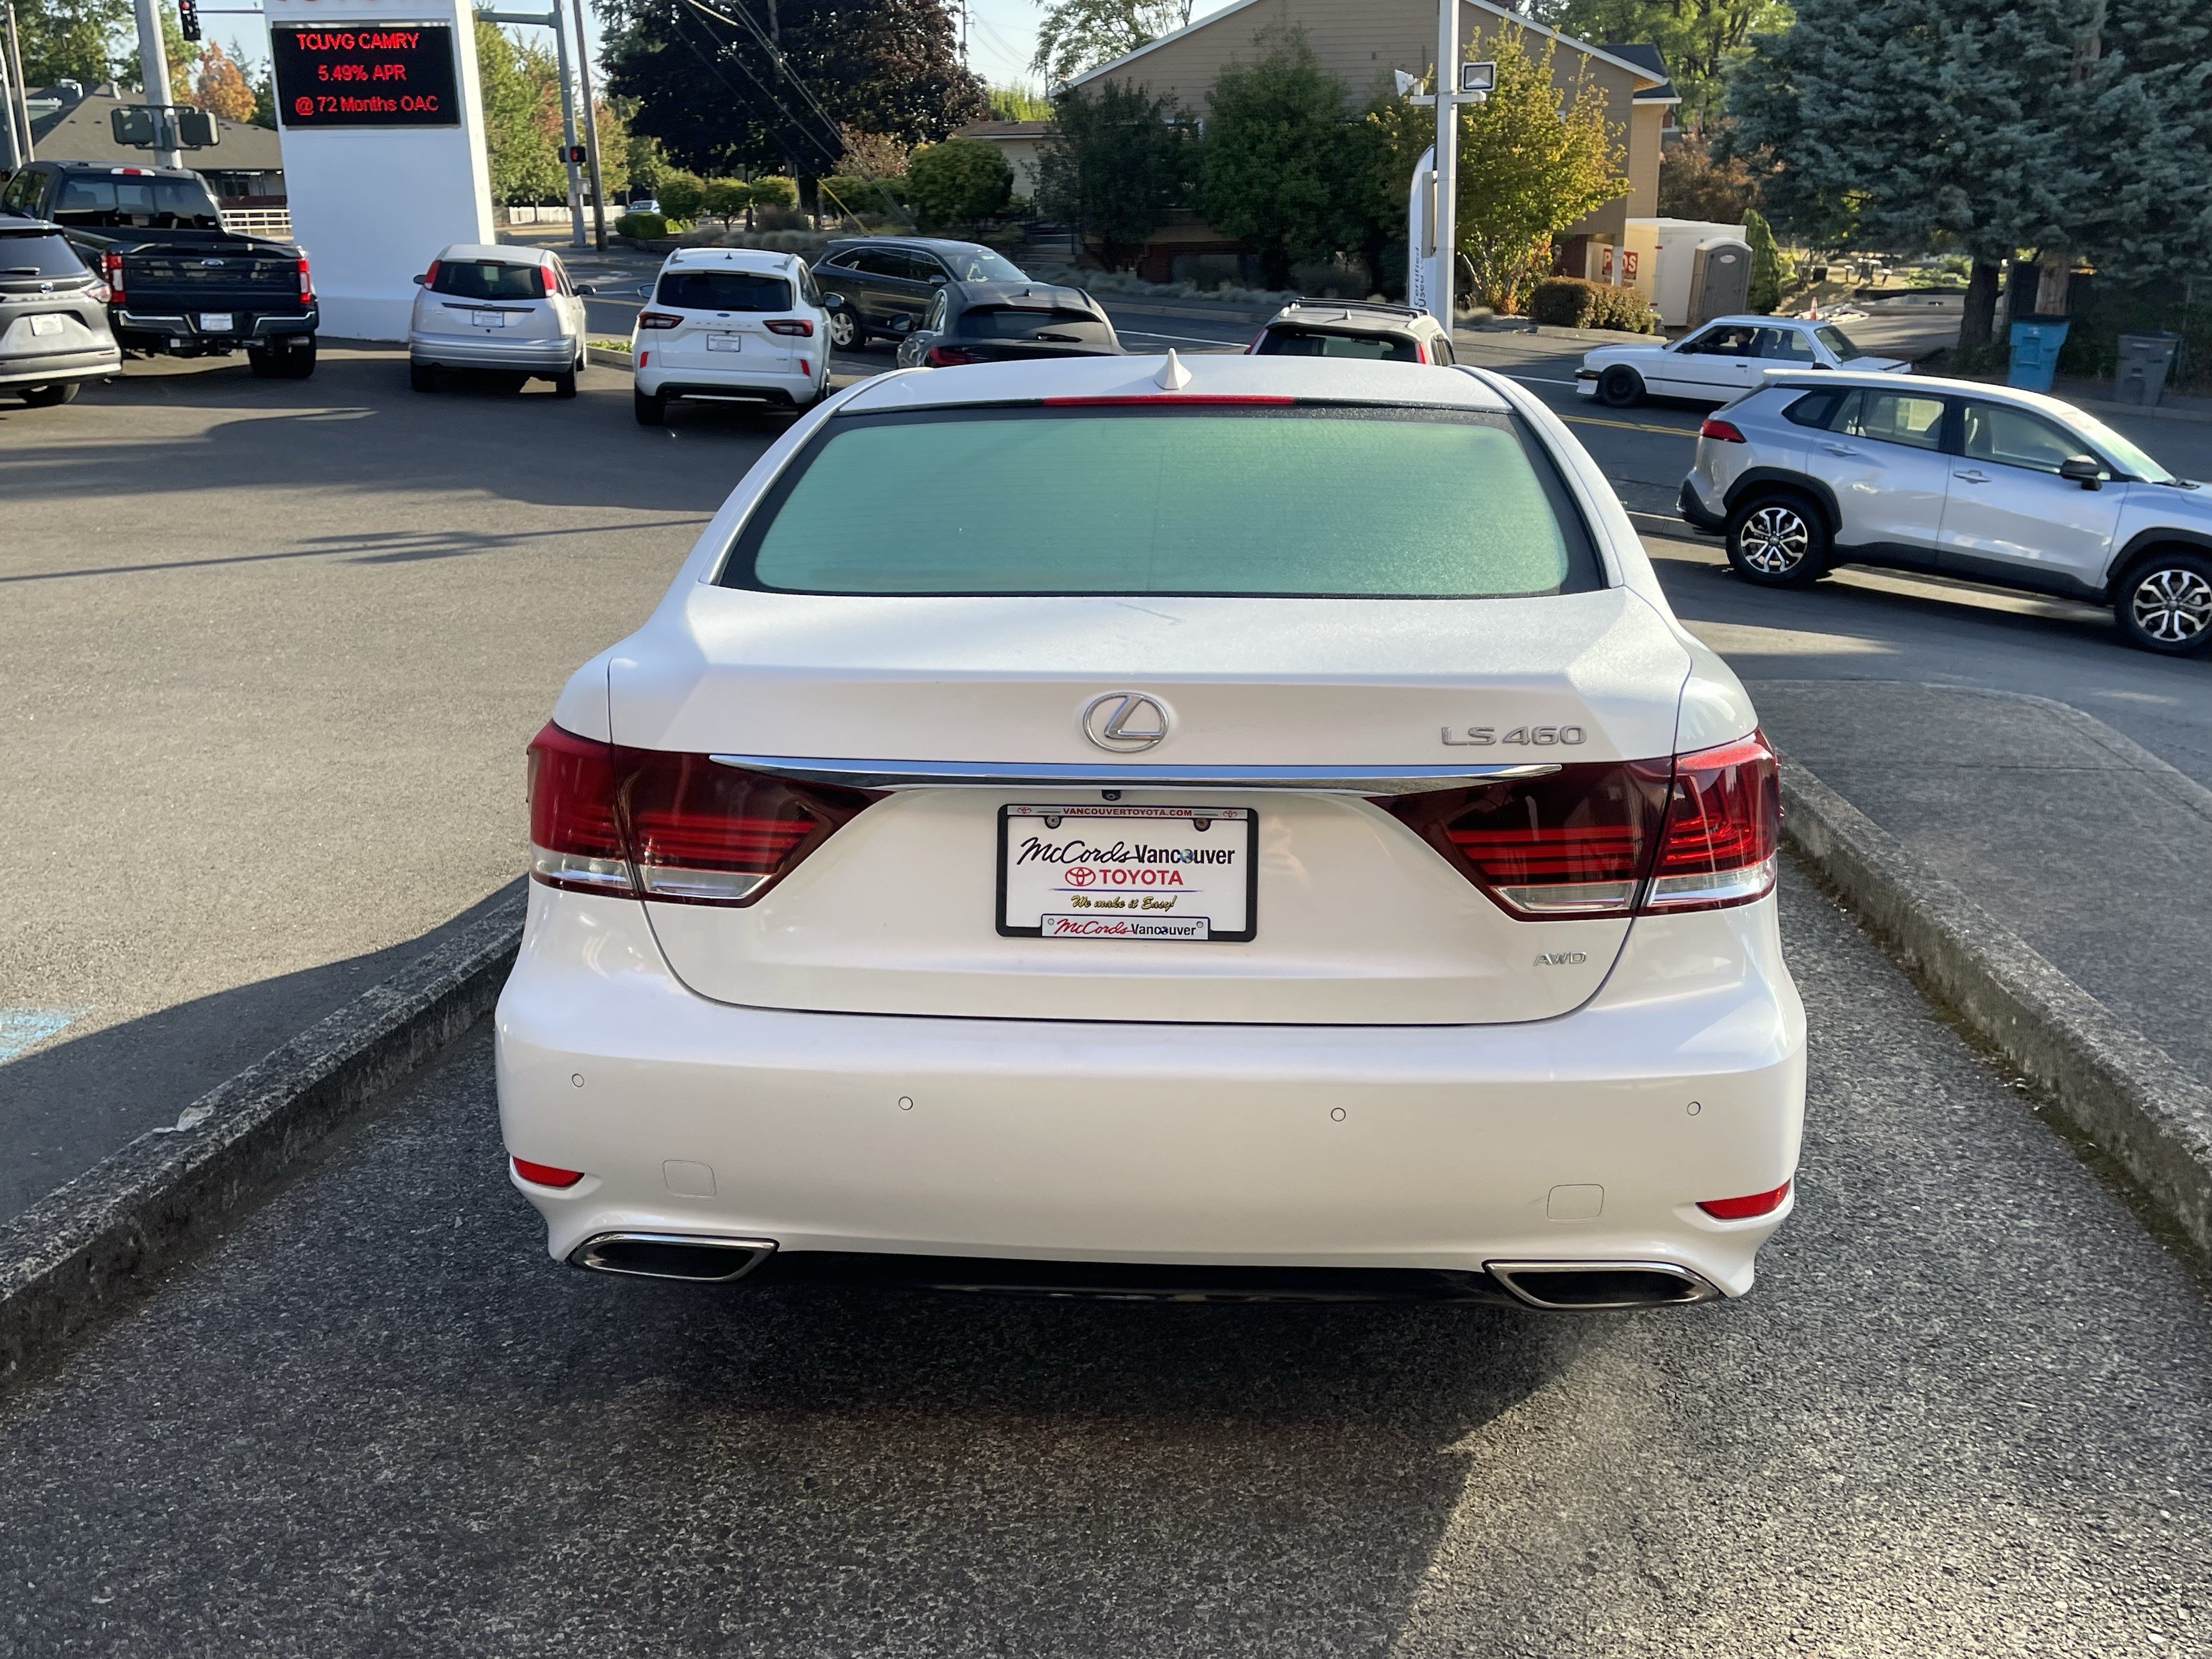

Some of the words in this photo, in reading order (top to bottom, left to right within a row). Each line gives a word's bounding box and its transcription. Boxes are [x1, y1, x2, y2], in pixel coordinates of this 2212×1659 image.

[358, 33, 420, 49] CAMRY
[318, 65, 369, 81] 5.49%
[373, 65, 407, 80] APR
[295, 97, 314, 115] @
[317, 97, 337, 111] 72
[340, 96, 397, 111] Months
[399, 95, 439, 111] OAC
[1441, 726, 1497, 746] LS
[1502, 725, 1587, 746] 460
[1063, 808, 1192, 817] VANCOUVERTOYOTA.COM
[1099, 869, 1184, 885] TOYOTA
[1071, 895, 1092, 908] We
[1093, 896, 1125, 909] make
[1127, 898, 1139, 909] it
[1141, 895, 1178, 912] Easy!
[1533, 951, 1587, 966] AWD
